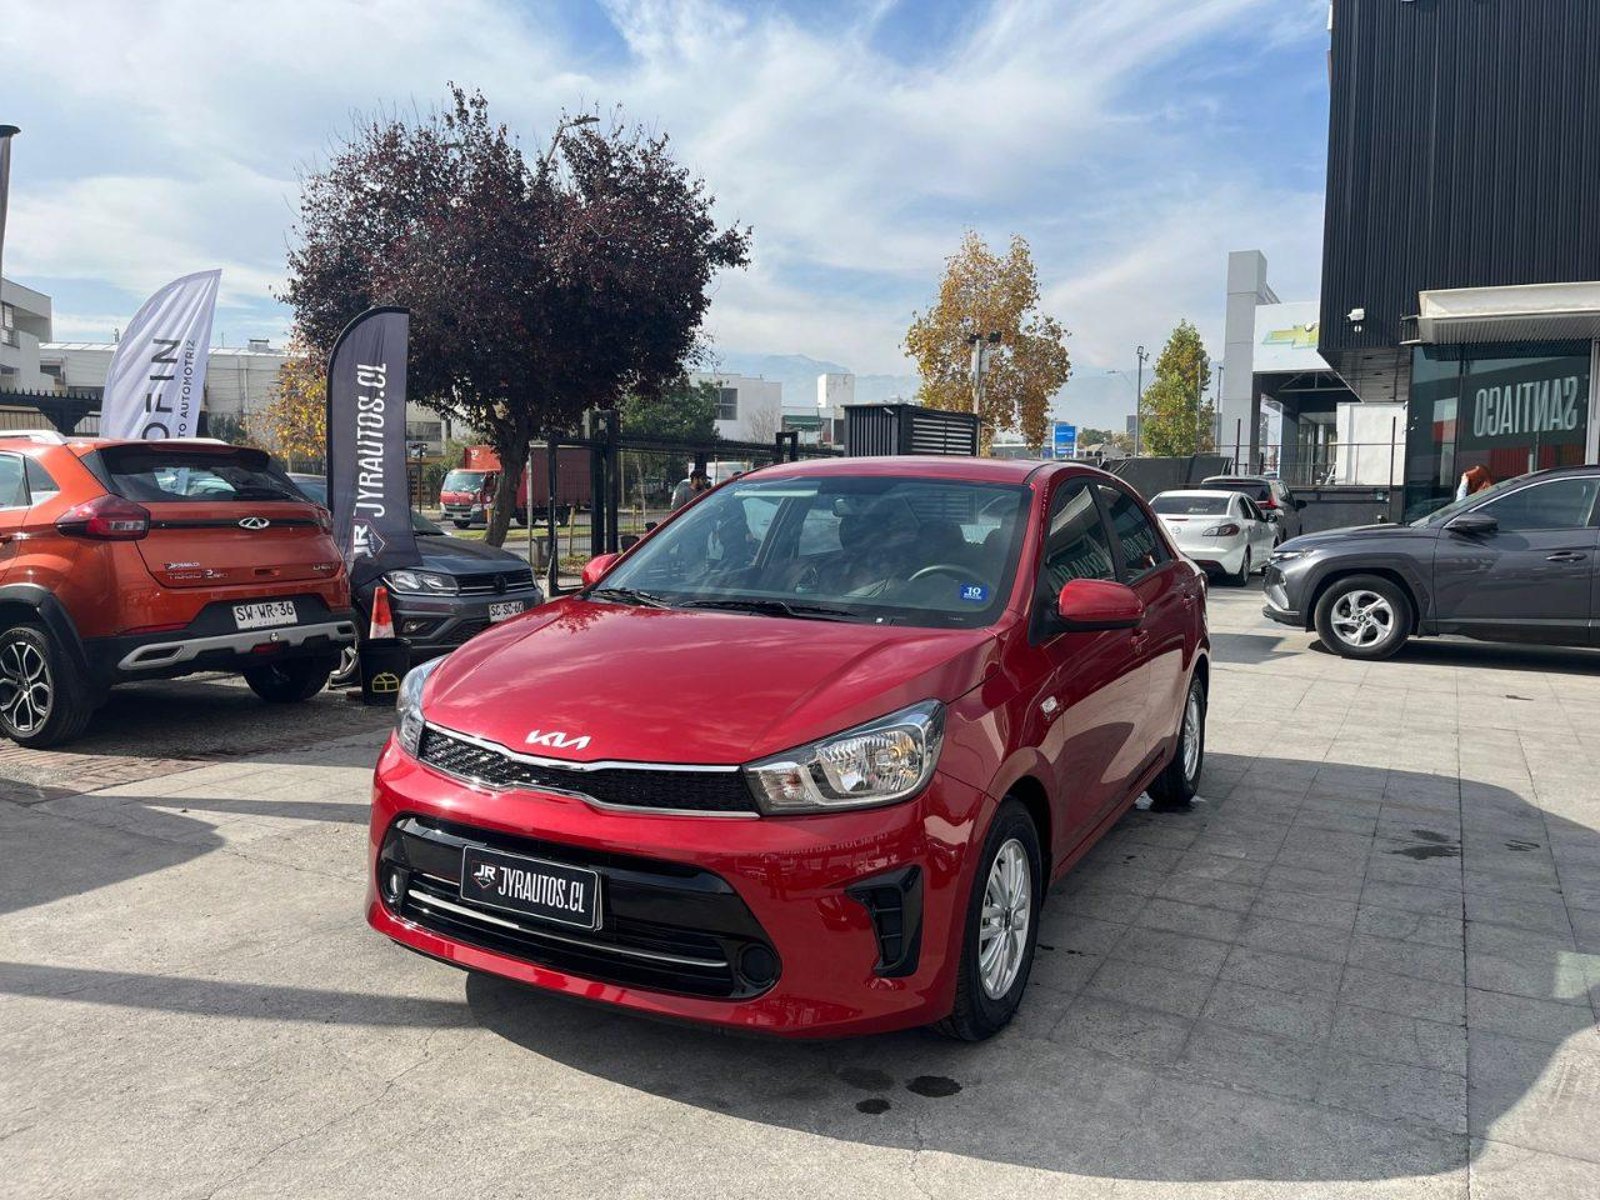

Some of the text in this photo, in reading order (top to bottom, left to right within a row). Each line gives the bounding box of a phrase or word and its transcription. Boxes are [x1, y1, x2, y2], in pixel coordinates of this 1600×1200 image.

[180, 340, 196, 418] AUTOMOTRIZ
[353, 363, 388, 518] JYRAUTOS.CL
[525, 730, 592, 750] KIA
[473, 864, 585, 913] JR JYRAUTOS.CL
